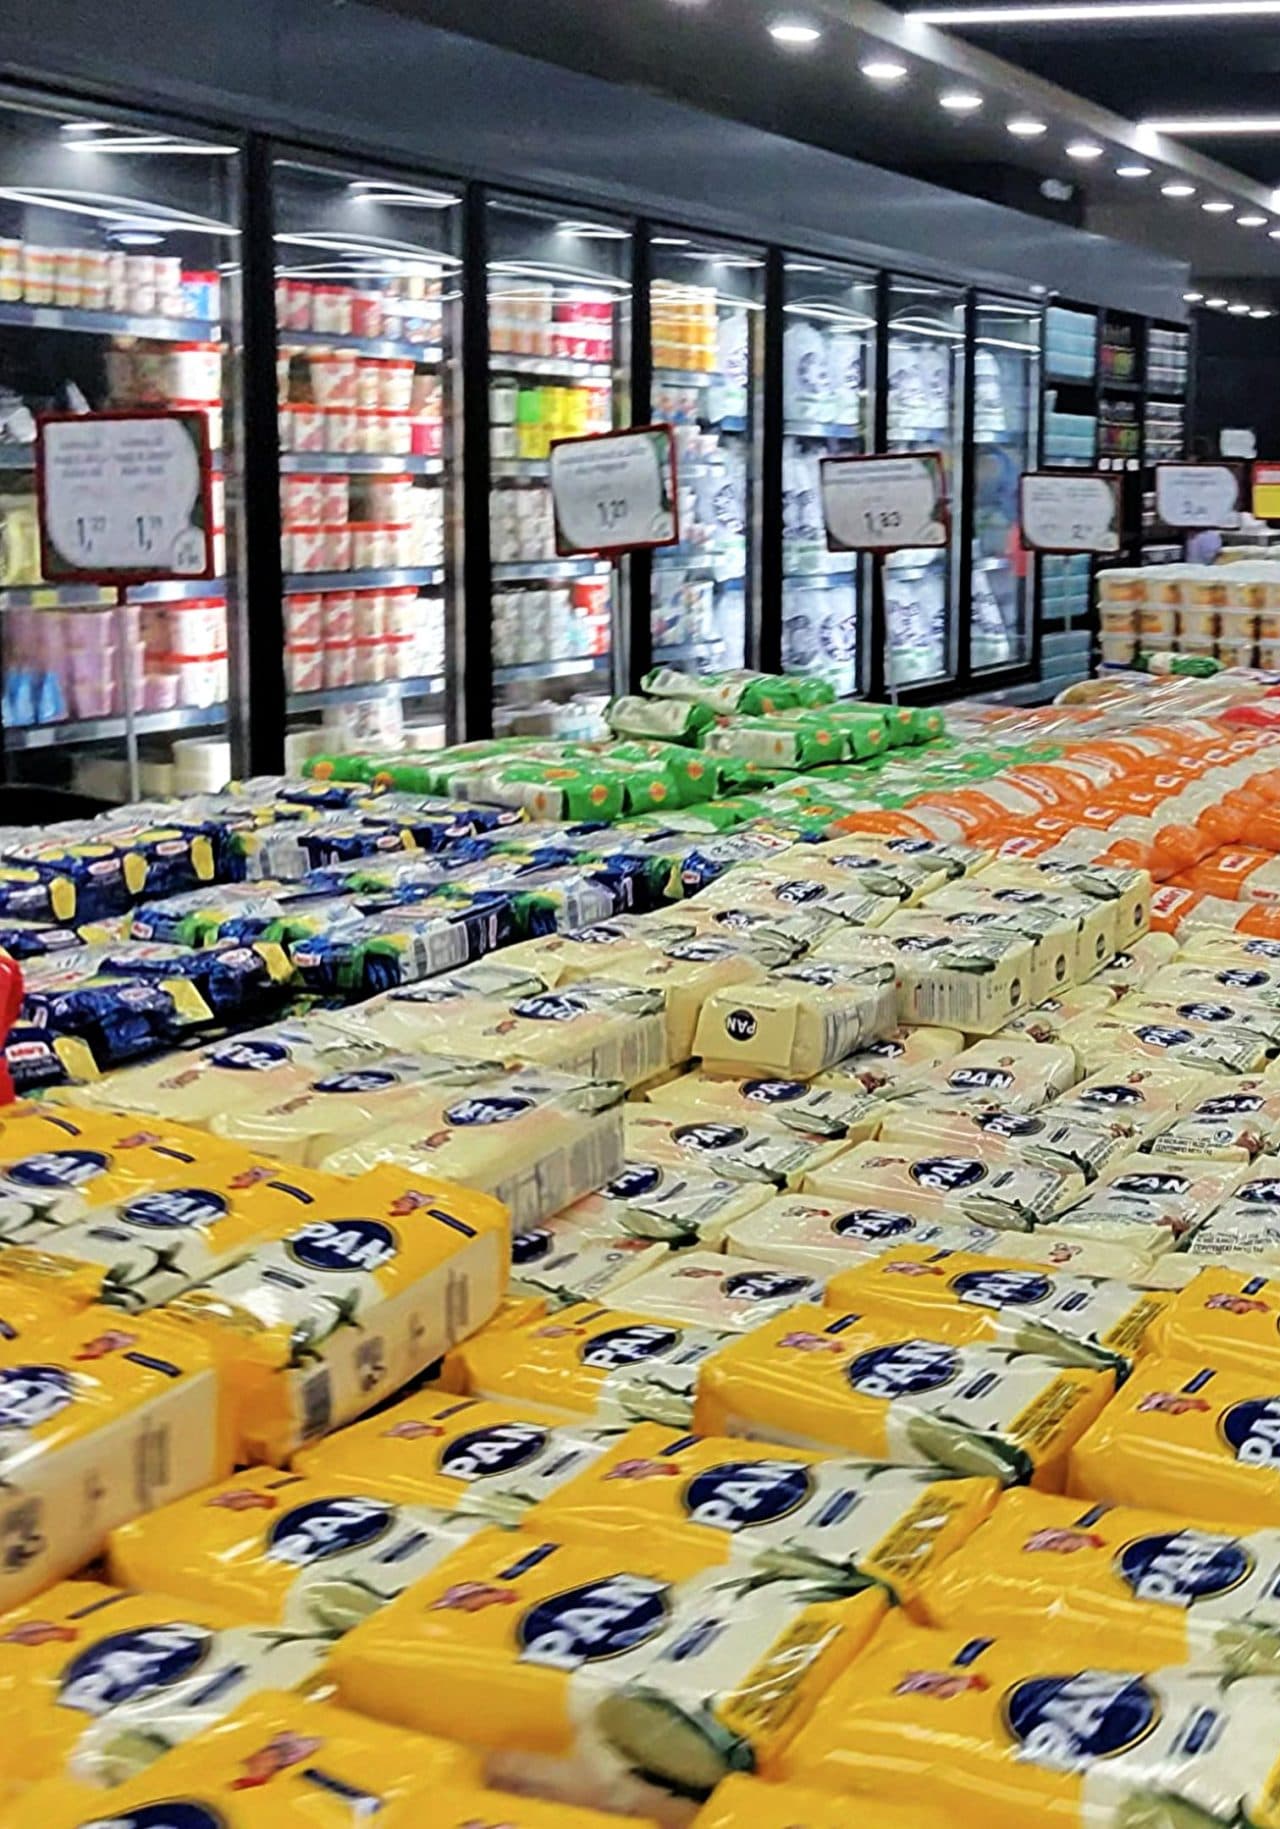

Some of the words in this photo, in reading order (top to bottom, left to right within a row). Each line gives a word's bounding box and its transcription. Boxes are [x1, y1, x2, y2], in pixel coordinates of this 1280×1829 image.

[727, 1017, 757, 1035] PAN
[287, 1222, 400, 1271] PAN
[583, 1323, 682, 1368] PAN
[858, 1340, 957, 1399] PAN
[440, 1423, 546, 1479] PAN
[686, 1461, 812, 1532] PAN
[266, 1497, 393, 1566] PAN
[520, 1574, 672, 1672] PAN
